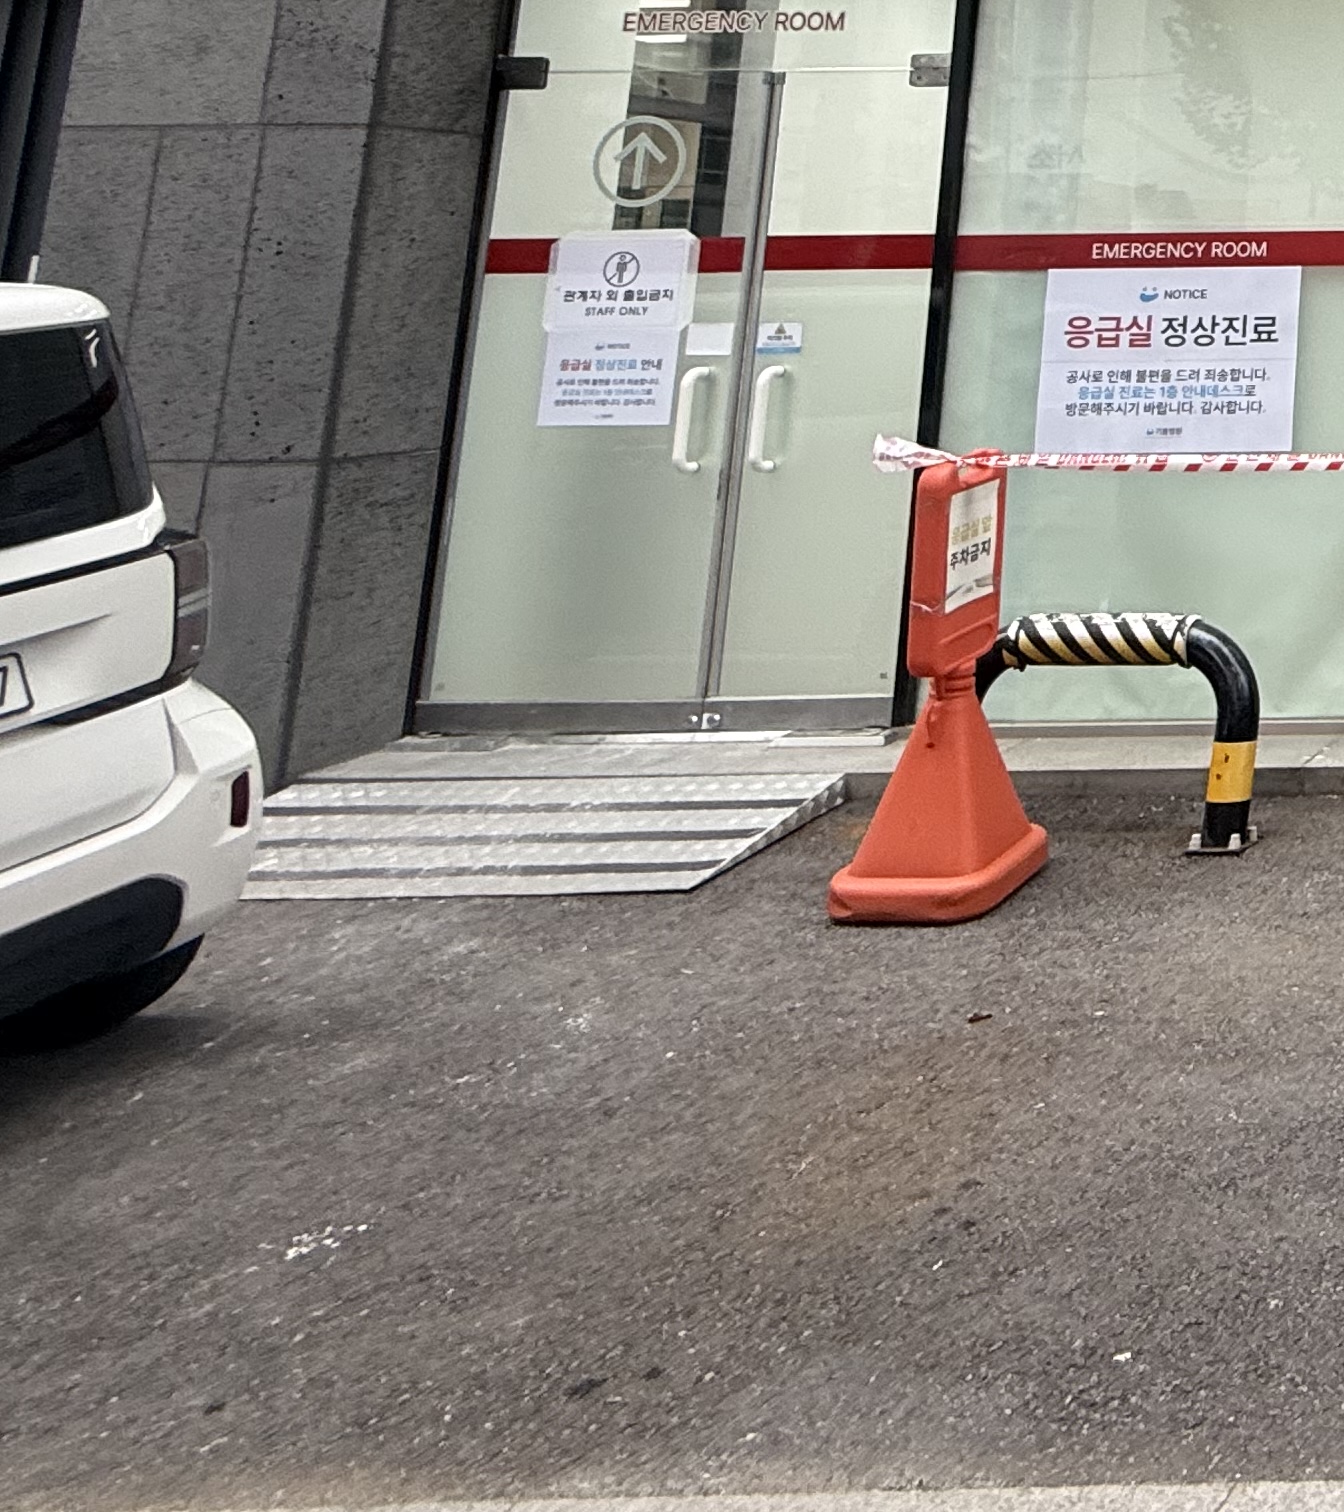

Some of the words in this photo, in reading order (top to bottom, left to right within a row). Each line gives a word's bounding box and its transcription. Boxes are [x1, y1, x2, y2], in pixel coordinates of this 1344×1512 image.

[622, 9, 767, 34] EMERGENCY
[775, 9, 846, 33] ROOM
[1091, 241, 1207, 260] EMERGENCY
[1211, 241, 1268, 259] ROOM
[1163, 287, 1208, 301] NOTICE
[584, 306, 616, 317] STAFF
[619, 306, 649, 316] ONLY
[1064, 315, 1153, 350] 응급실
[1160, 314, 1279, 348] 정상진료
[1066, 369, 1104, 384] 공사로
[1107, 369, 1132, 383] 인해
[1175, 368, 1200, 383] 드려
[1078, 385, 1115, 399] 응급실
[1119, 386, 1156, 399] 진료는
[1065, 402, 1140, 417] 방문해주시기
[949, 537, 992, 571] 주차금지
